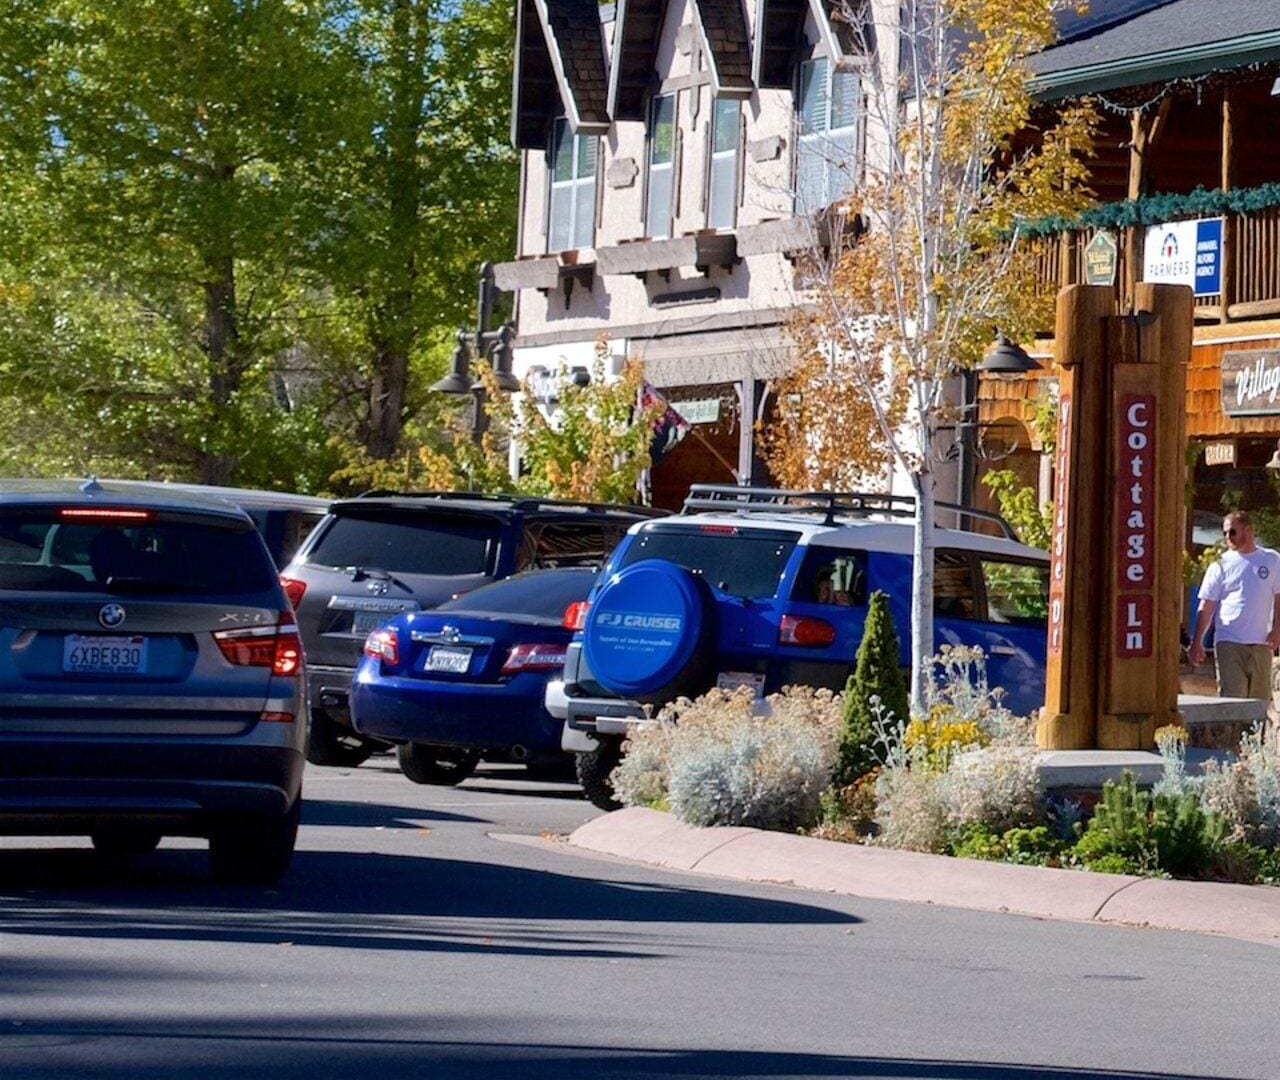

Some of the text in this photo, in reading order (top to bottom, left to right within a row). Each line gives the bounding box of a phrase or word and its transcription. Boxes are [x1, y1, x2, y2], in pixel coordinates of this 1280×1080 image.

[1150, 260, 1190, 278] FARMERS
[1196, 265, 1216, 277] AGENCY
[1053, 401, 1071, 580] Village
[1125, 402, 1149, 651] Cottage Ln
[597, 612, 681, 630] FJ CRUISER
[70, 647, 141, 666] 6XBE830
